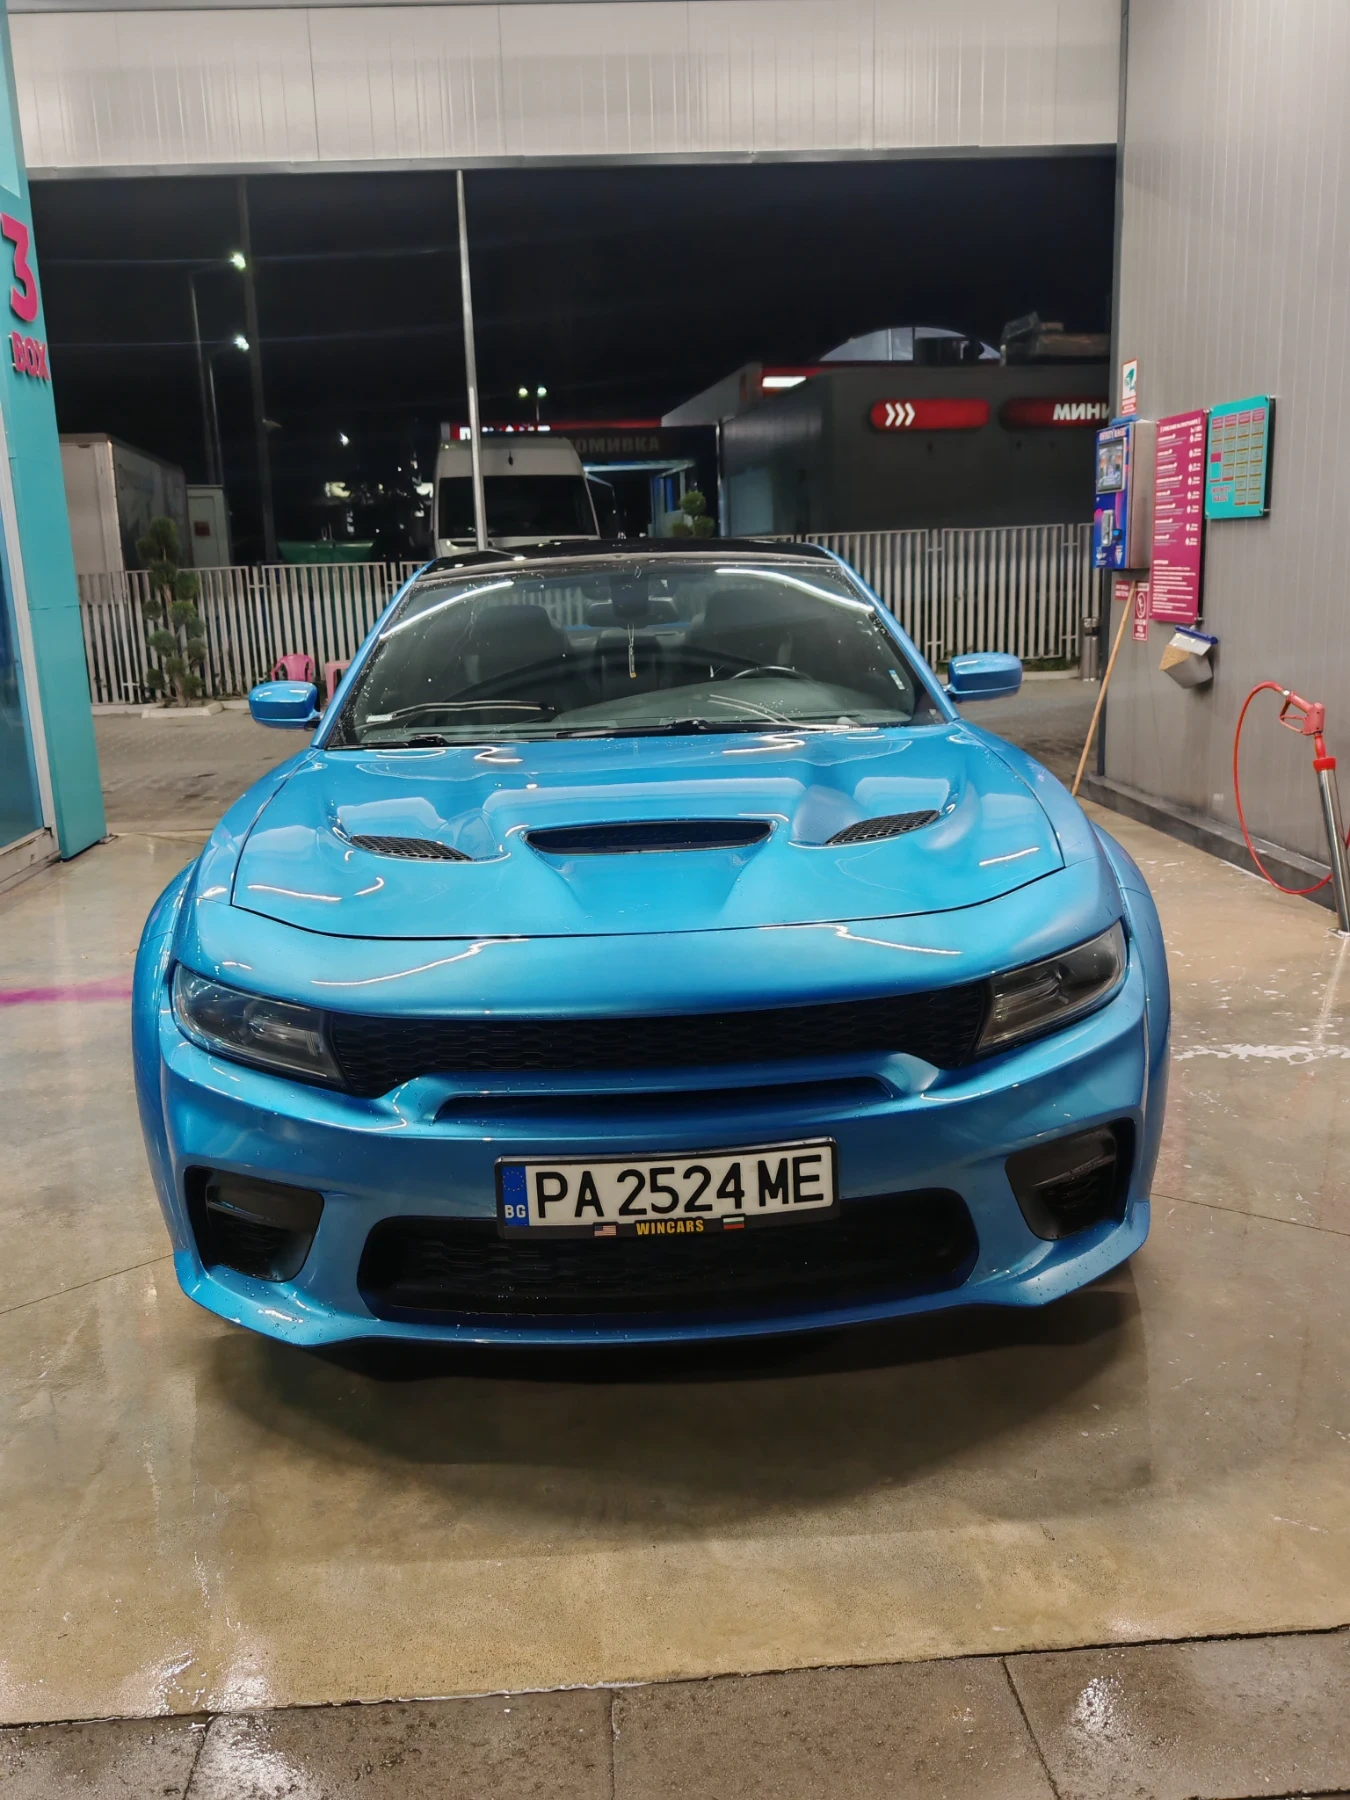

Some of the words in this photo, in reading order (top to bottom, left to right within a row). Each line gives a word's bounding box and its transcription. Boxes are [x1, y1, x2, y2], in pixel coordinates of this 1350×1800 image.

[1, 212, 38, 321] 3
[12, 331, 50, 380] BOX
[573, 436, 661, 453] ОМИВКА
[535, 1171, 604, 1218] PA
[617, 1162, 745, 1216] 2524
[757, 1154, 825, 1207] ME
[504, 1204, 526, 1219] BG
[636, 1219, 704, 1236] WINCARS
